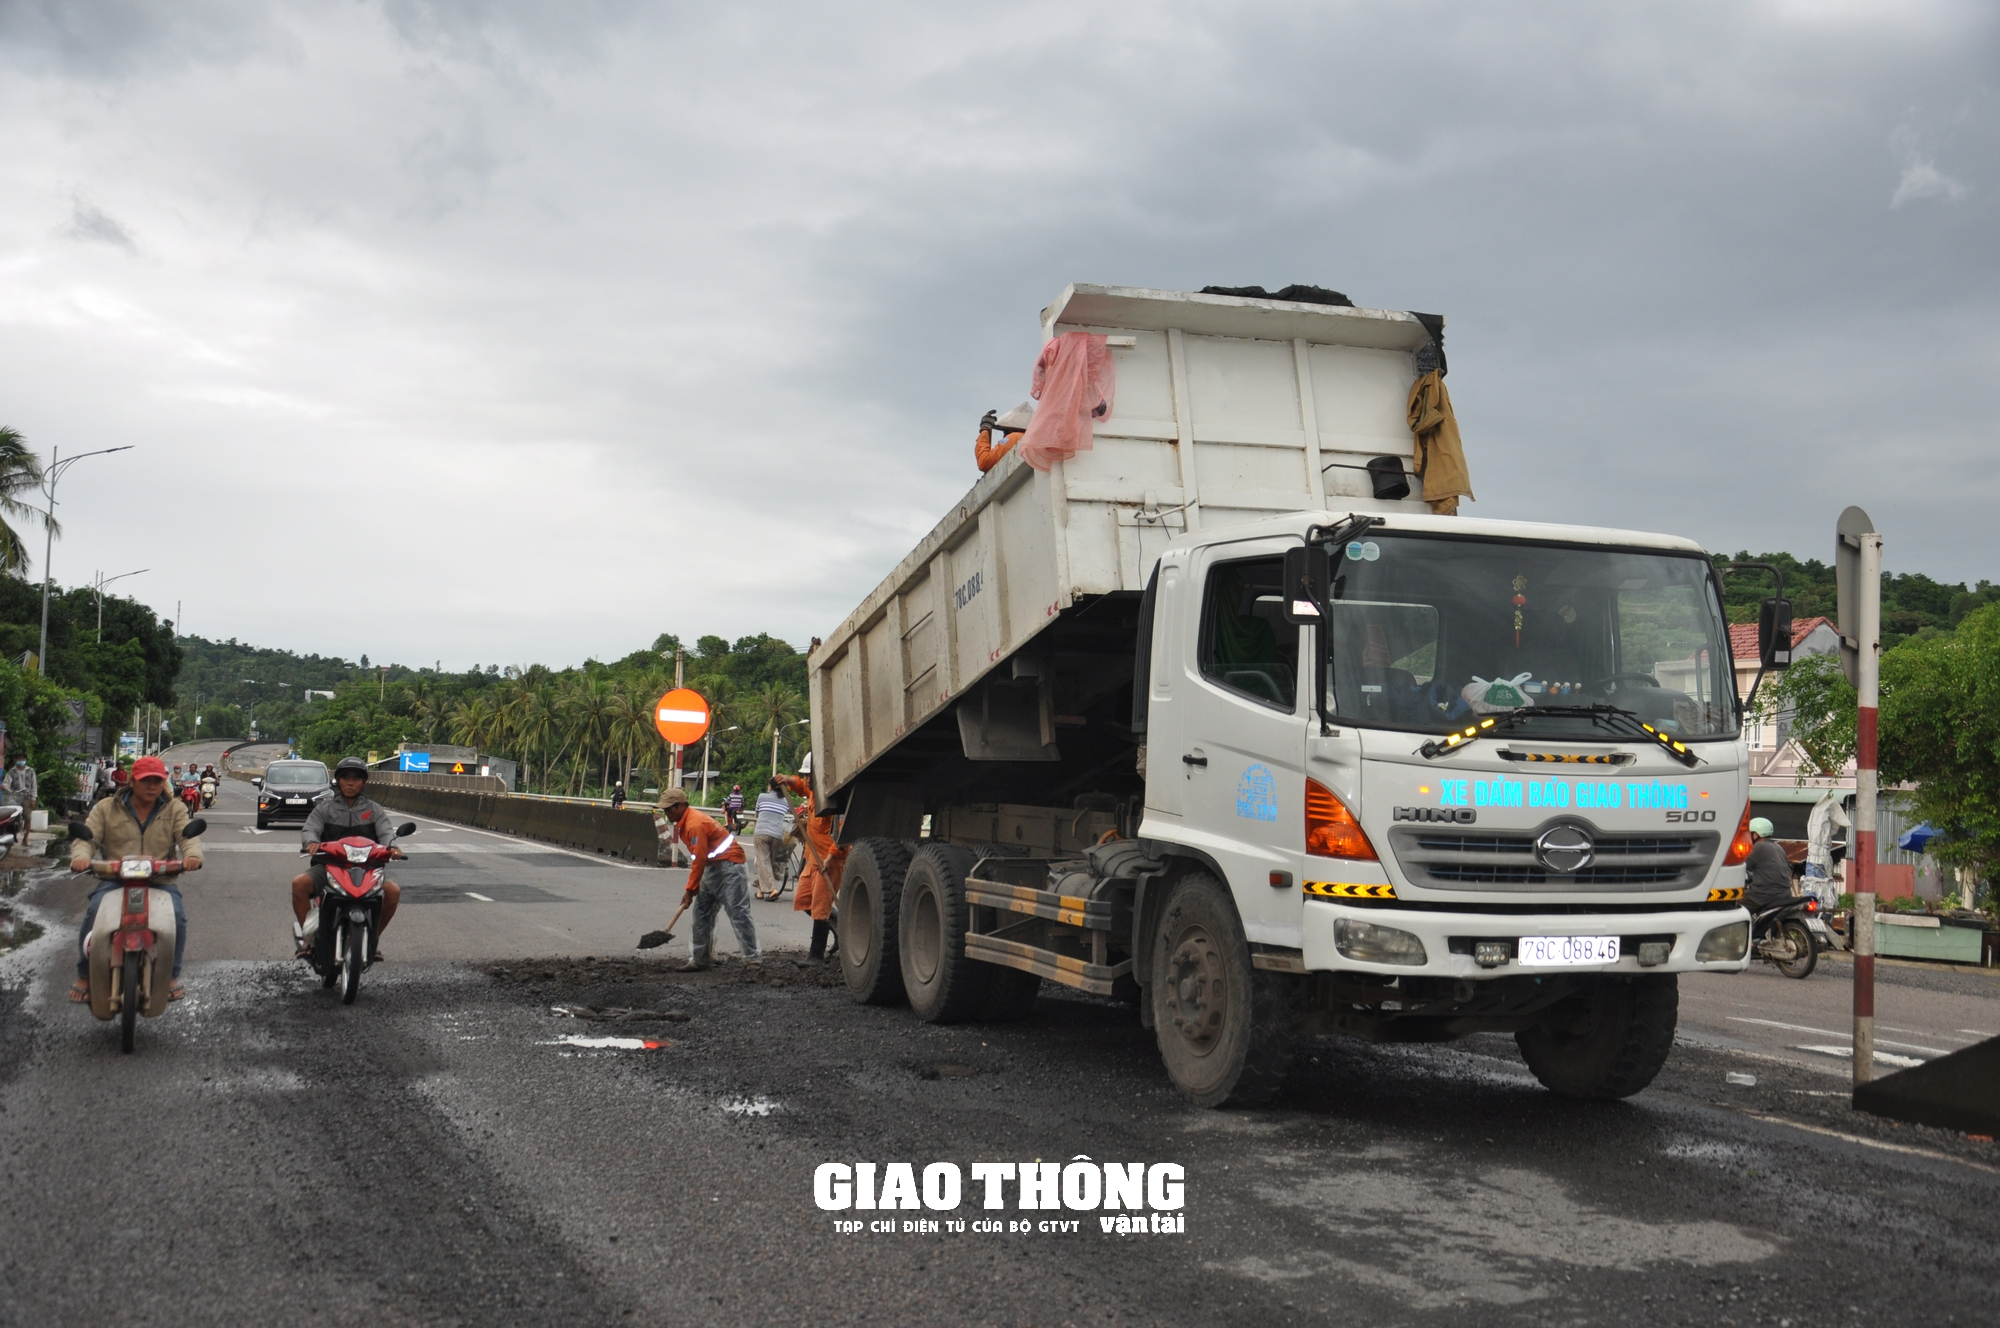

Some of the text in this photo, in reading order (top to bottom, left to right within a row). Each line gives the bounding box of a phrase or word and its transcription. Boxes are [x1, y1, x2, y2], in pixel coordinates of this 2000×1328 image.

[1440, 774, 1688, 809] XE ĐẢM BẢO GIAO THÔNG
[1393, 806, 1477, 824] HINO
[1665, 810, 1717, 823] 500
